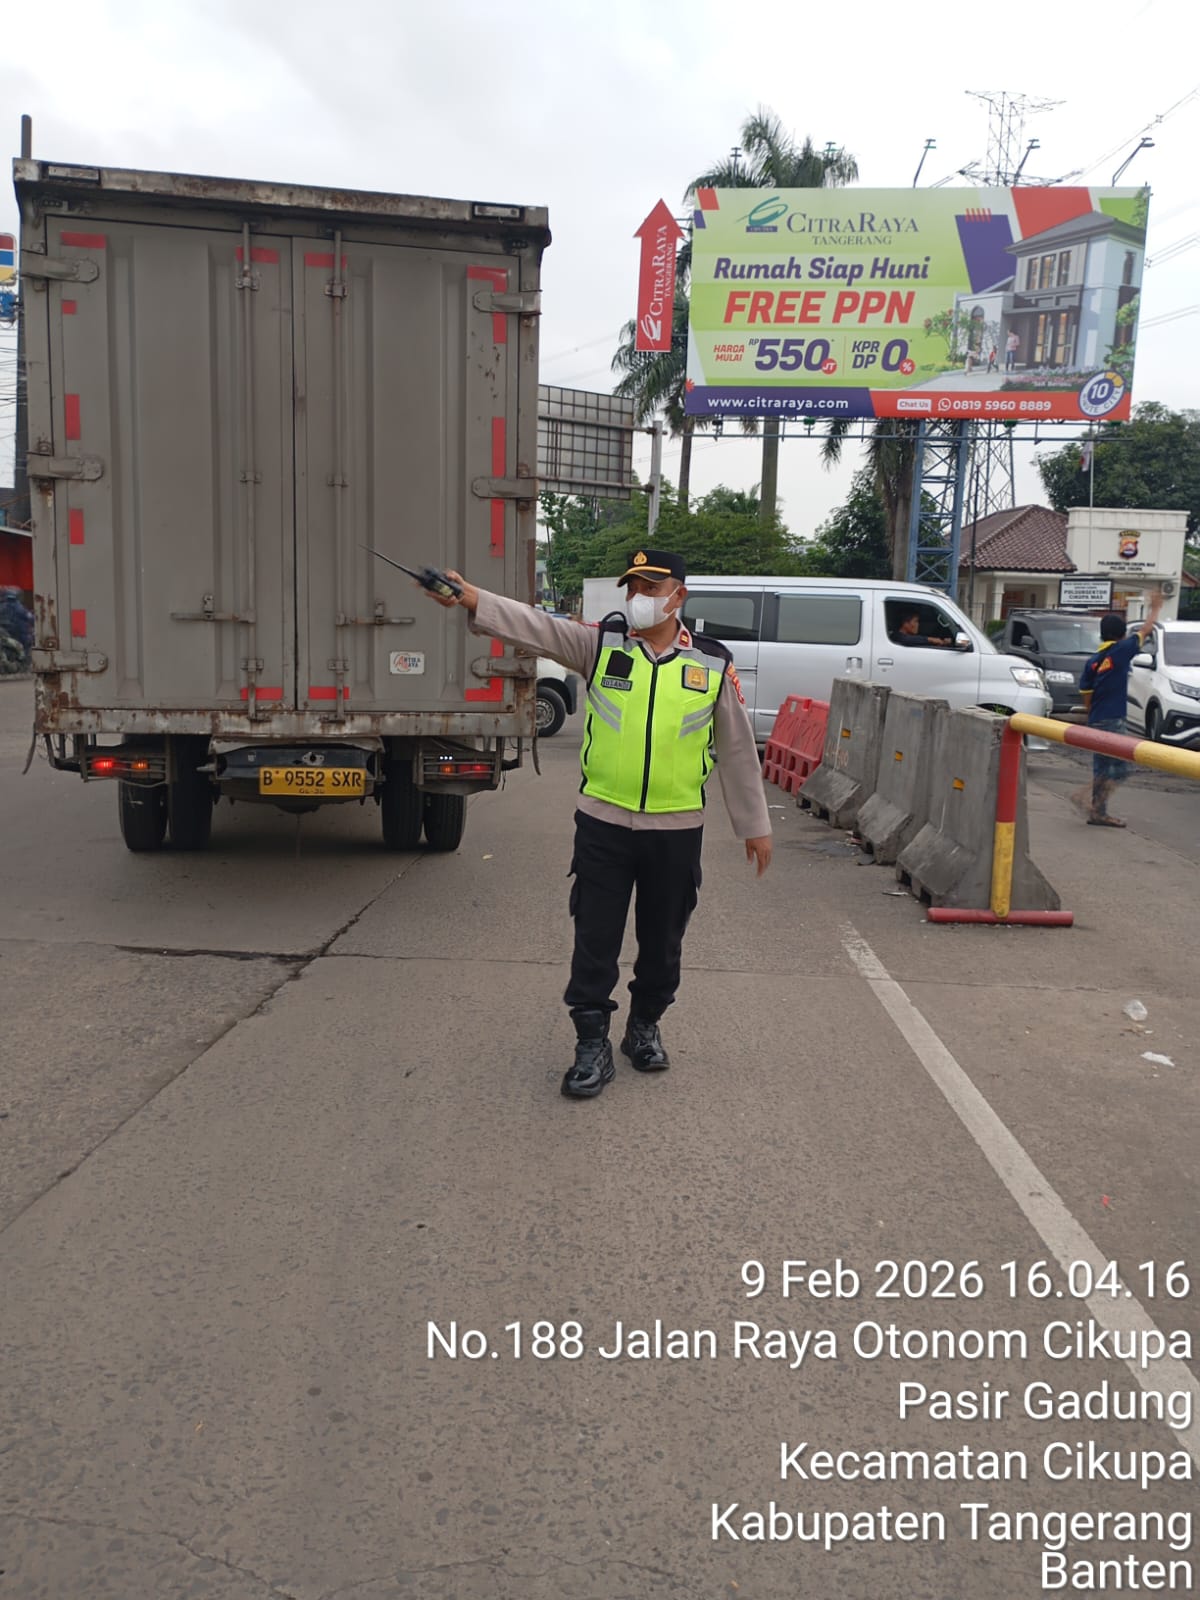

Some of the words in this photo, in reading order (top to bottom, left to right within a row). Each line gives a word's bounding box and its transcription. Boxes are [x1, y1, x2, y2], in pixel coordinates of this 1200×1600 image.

[811, 235, 892, 246] TANGERANG
[664, 242, 674, 298] TANGERANG
[713, 256, 802, 279] Rumah
[808, 256, 864, 287] Siap
[869, 256, 931, 279] Huni
[723, 290, 827, 324] FREE
[832, 290, 916, 324] PPN
[713, 344, 745, 354] HARGA
[851, 340, 880, 353] KPR
[715, 353, 743, 362] MULAI
[755, 338, 831, 372] 550
[851, 354, 877, 369] DP
[1091, 382, 1109, 400] 10
[707, 395, 849, 411] www.citraraya.com
[898, 400, 918, 409] Chat
[919, 400, 929, 409] Us
[953, 400, 981, 410] 0819
[984, 400, 1016, 411] 5960
[1019, 401, 1052, 411] 8889
[263, 770, 273, 786] B
[284, 770, 325, 787] 9552
[331, 771, 362, 787] SXR
